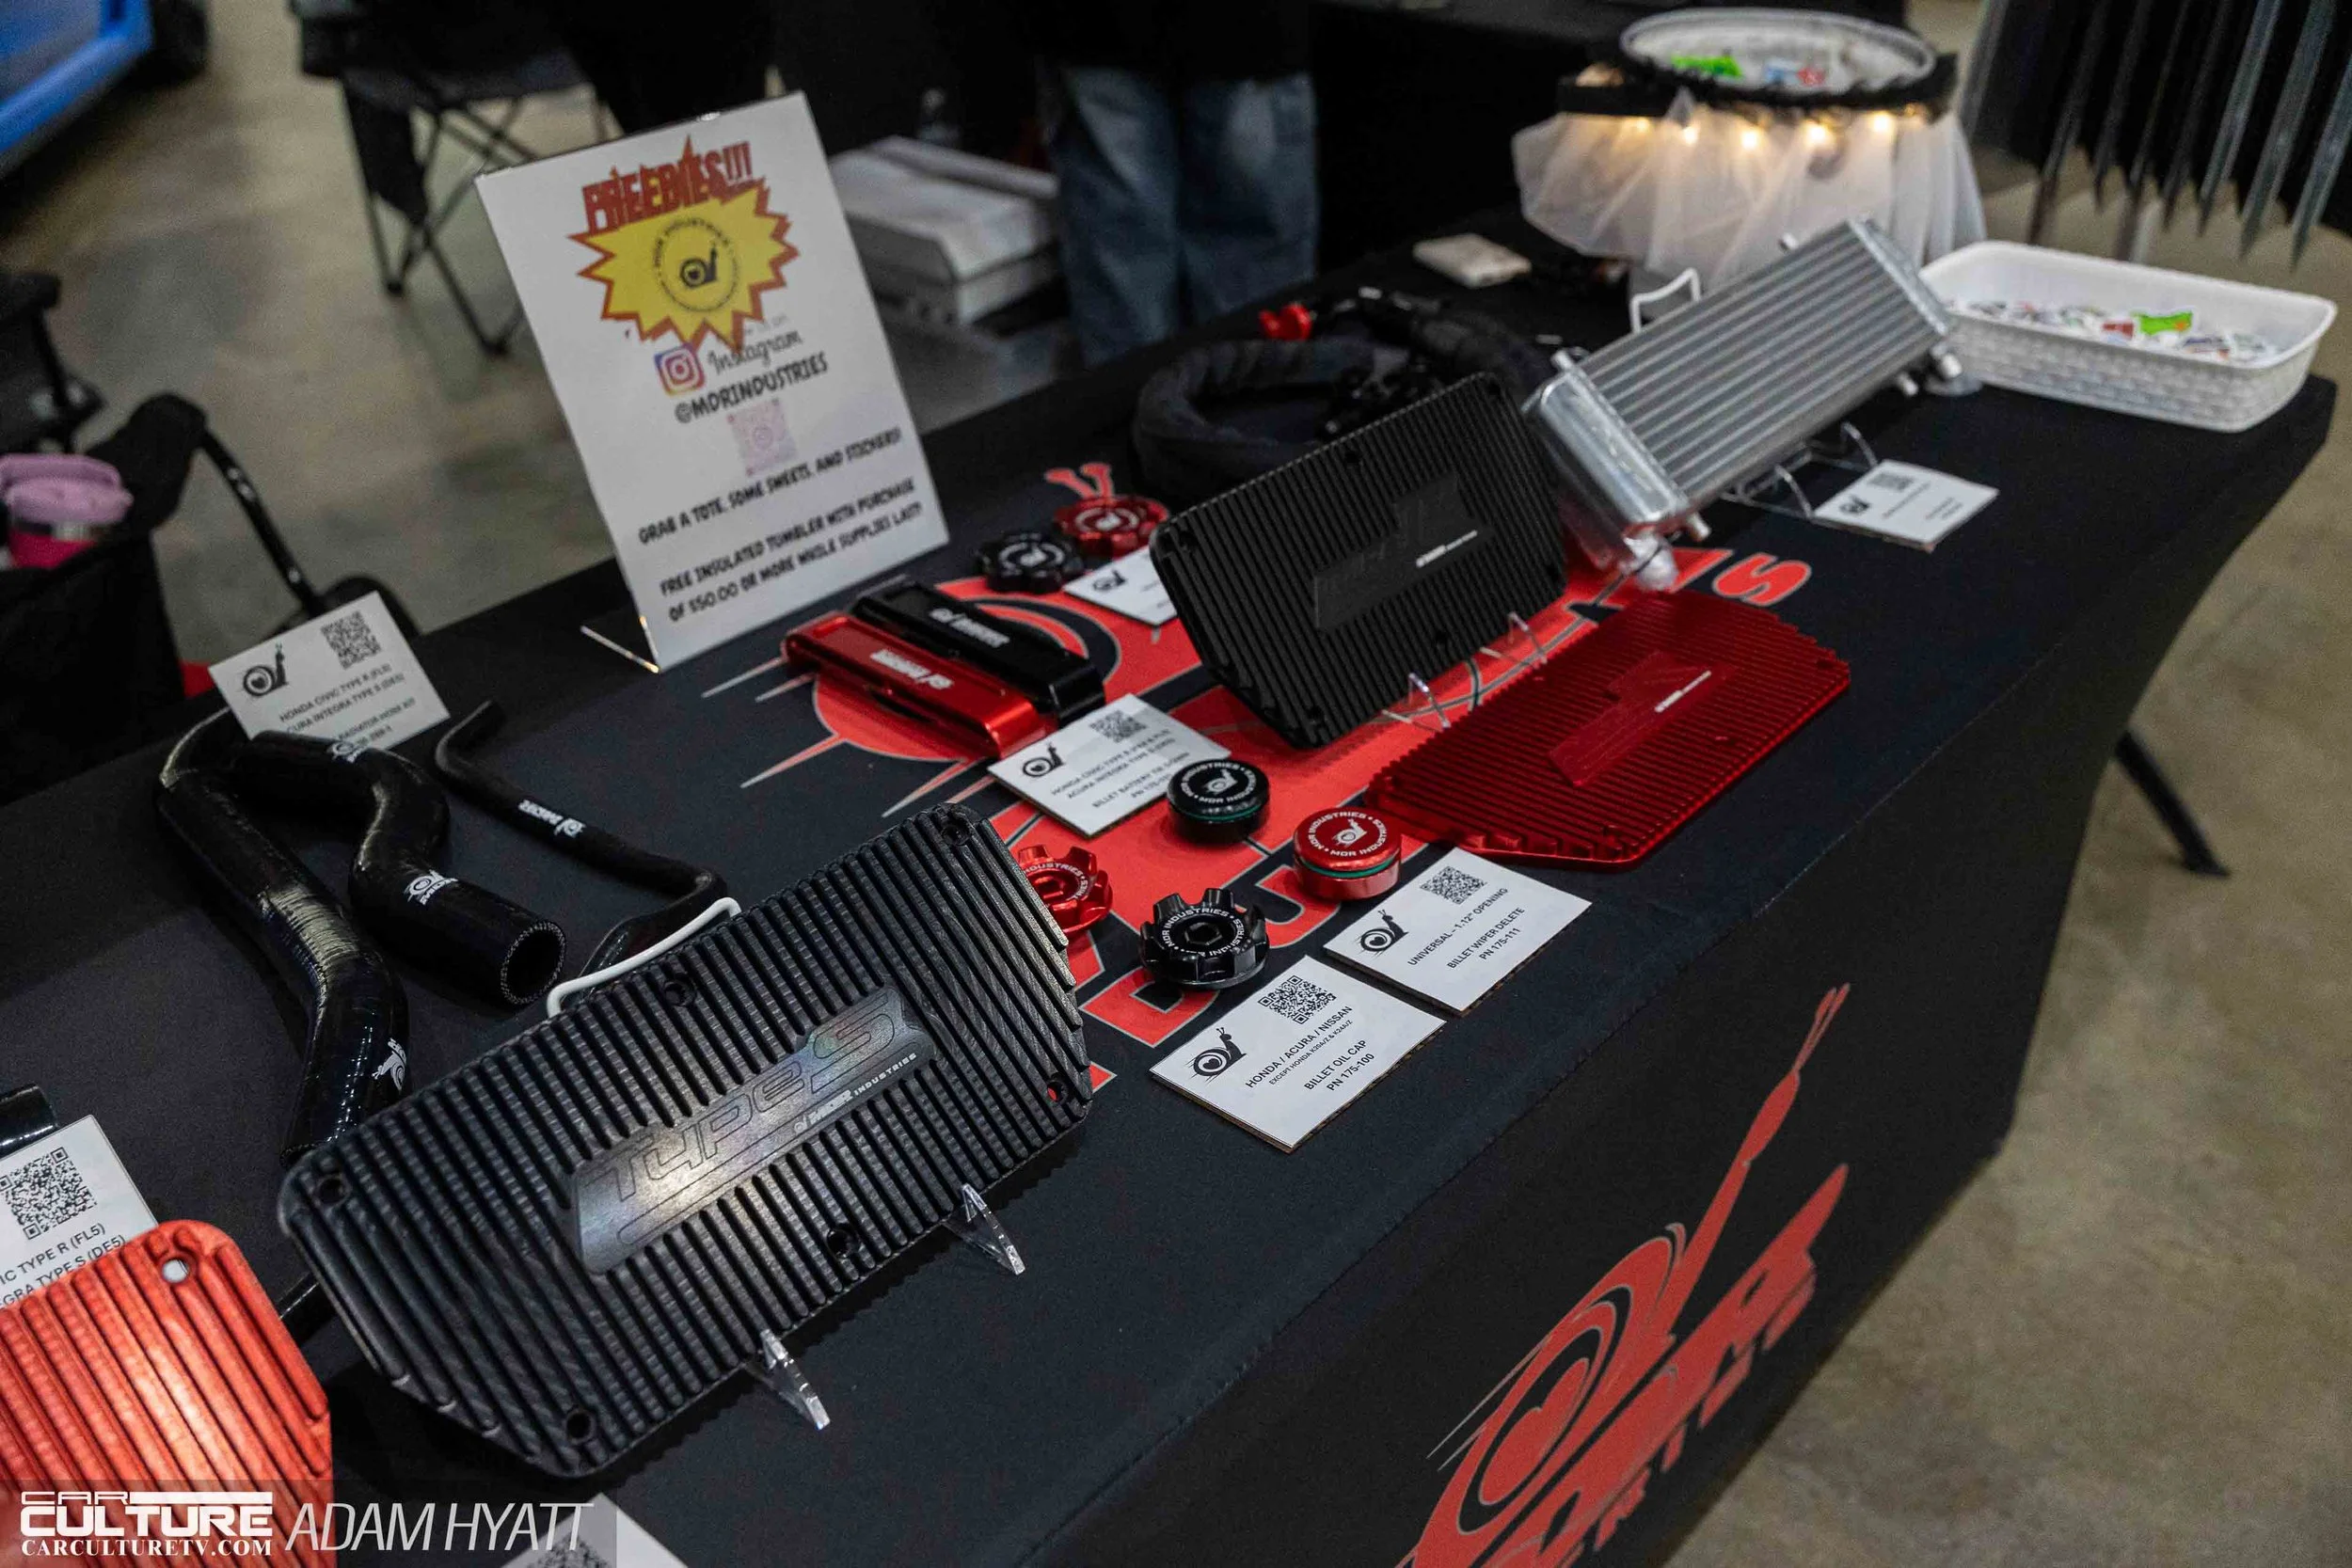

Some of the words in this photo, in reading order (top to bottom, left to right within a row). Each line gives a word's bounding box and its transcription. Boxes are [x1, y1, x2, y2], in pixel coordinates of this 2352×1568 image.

[639, 515, 677, 545] GRAB
[679, 512, 691, 528] A
[728, 480, 764, 509] SOME
[816, 449, 843, 472] AND
[660, 570, 692, 596] FREE
[693, 540, 764, 583] INSULATED
[766, 515, 824, 551] TUMBLER
[826, 503, 856, 526] WITH
[857, 476, 914, 513] PURCHASE
[668, 602, 685, 622] OF
[740, 572, 757, 592] OR
[758, 556, 795, 582] MORE
[797, 537, 836, 565] WHILE
[838, 515, 891, 548] SUPPLIES
[279, 701, 314, 722] HONDA
[1308, 811, 1367, 834] INDUSTRIES
[1164, 908, 1230, 929] INDUSTRIES
[1407, 932, 1453, 966] UNIVERSAL
[1472, 888, 1508, 915] OPENING
[1447, 947, 1473, 969] BILLET
[1471, 927, 1499, 949] WIPER
[1497, 907, 1525, 930] DELETE
[1479, 949, 1494, 960] PN
[1491, 927, 1521, 950] 175-111
[1246, 1060, 1281, 1088] HONDA
[1284, 1034, 1316, 1059] ACURA
[1318, 1006, 1353, 1032] NISSAN
[1269, 1067, 1291, 1085] EXCEPT
[1291, 1053, 1312, 1069] HONDA
[1304, 1065, 1333, 1090] BILLET
[1332, 1054, 1351, 1067] OIL
[1347, 1039, 1367, 1055] CAP
[1327, 1078, 1343, 1091] PN
[1341, 1053, 1375, 1079] 175-100
[853, 1053, 917, 1096] INDUSTRIES
[17, 1248, 56, 1275] TYPE
[57, 1242, 71, 1254] R
[71, 1223, 105, 1249] (FL5)
[36, 1262, 72, 1286] TYPE
[75, 1256, 86, 1267] S
[87, 1235, 126, 1260] (DE5)
